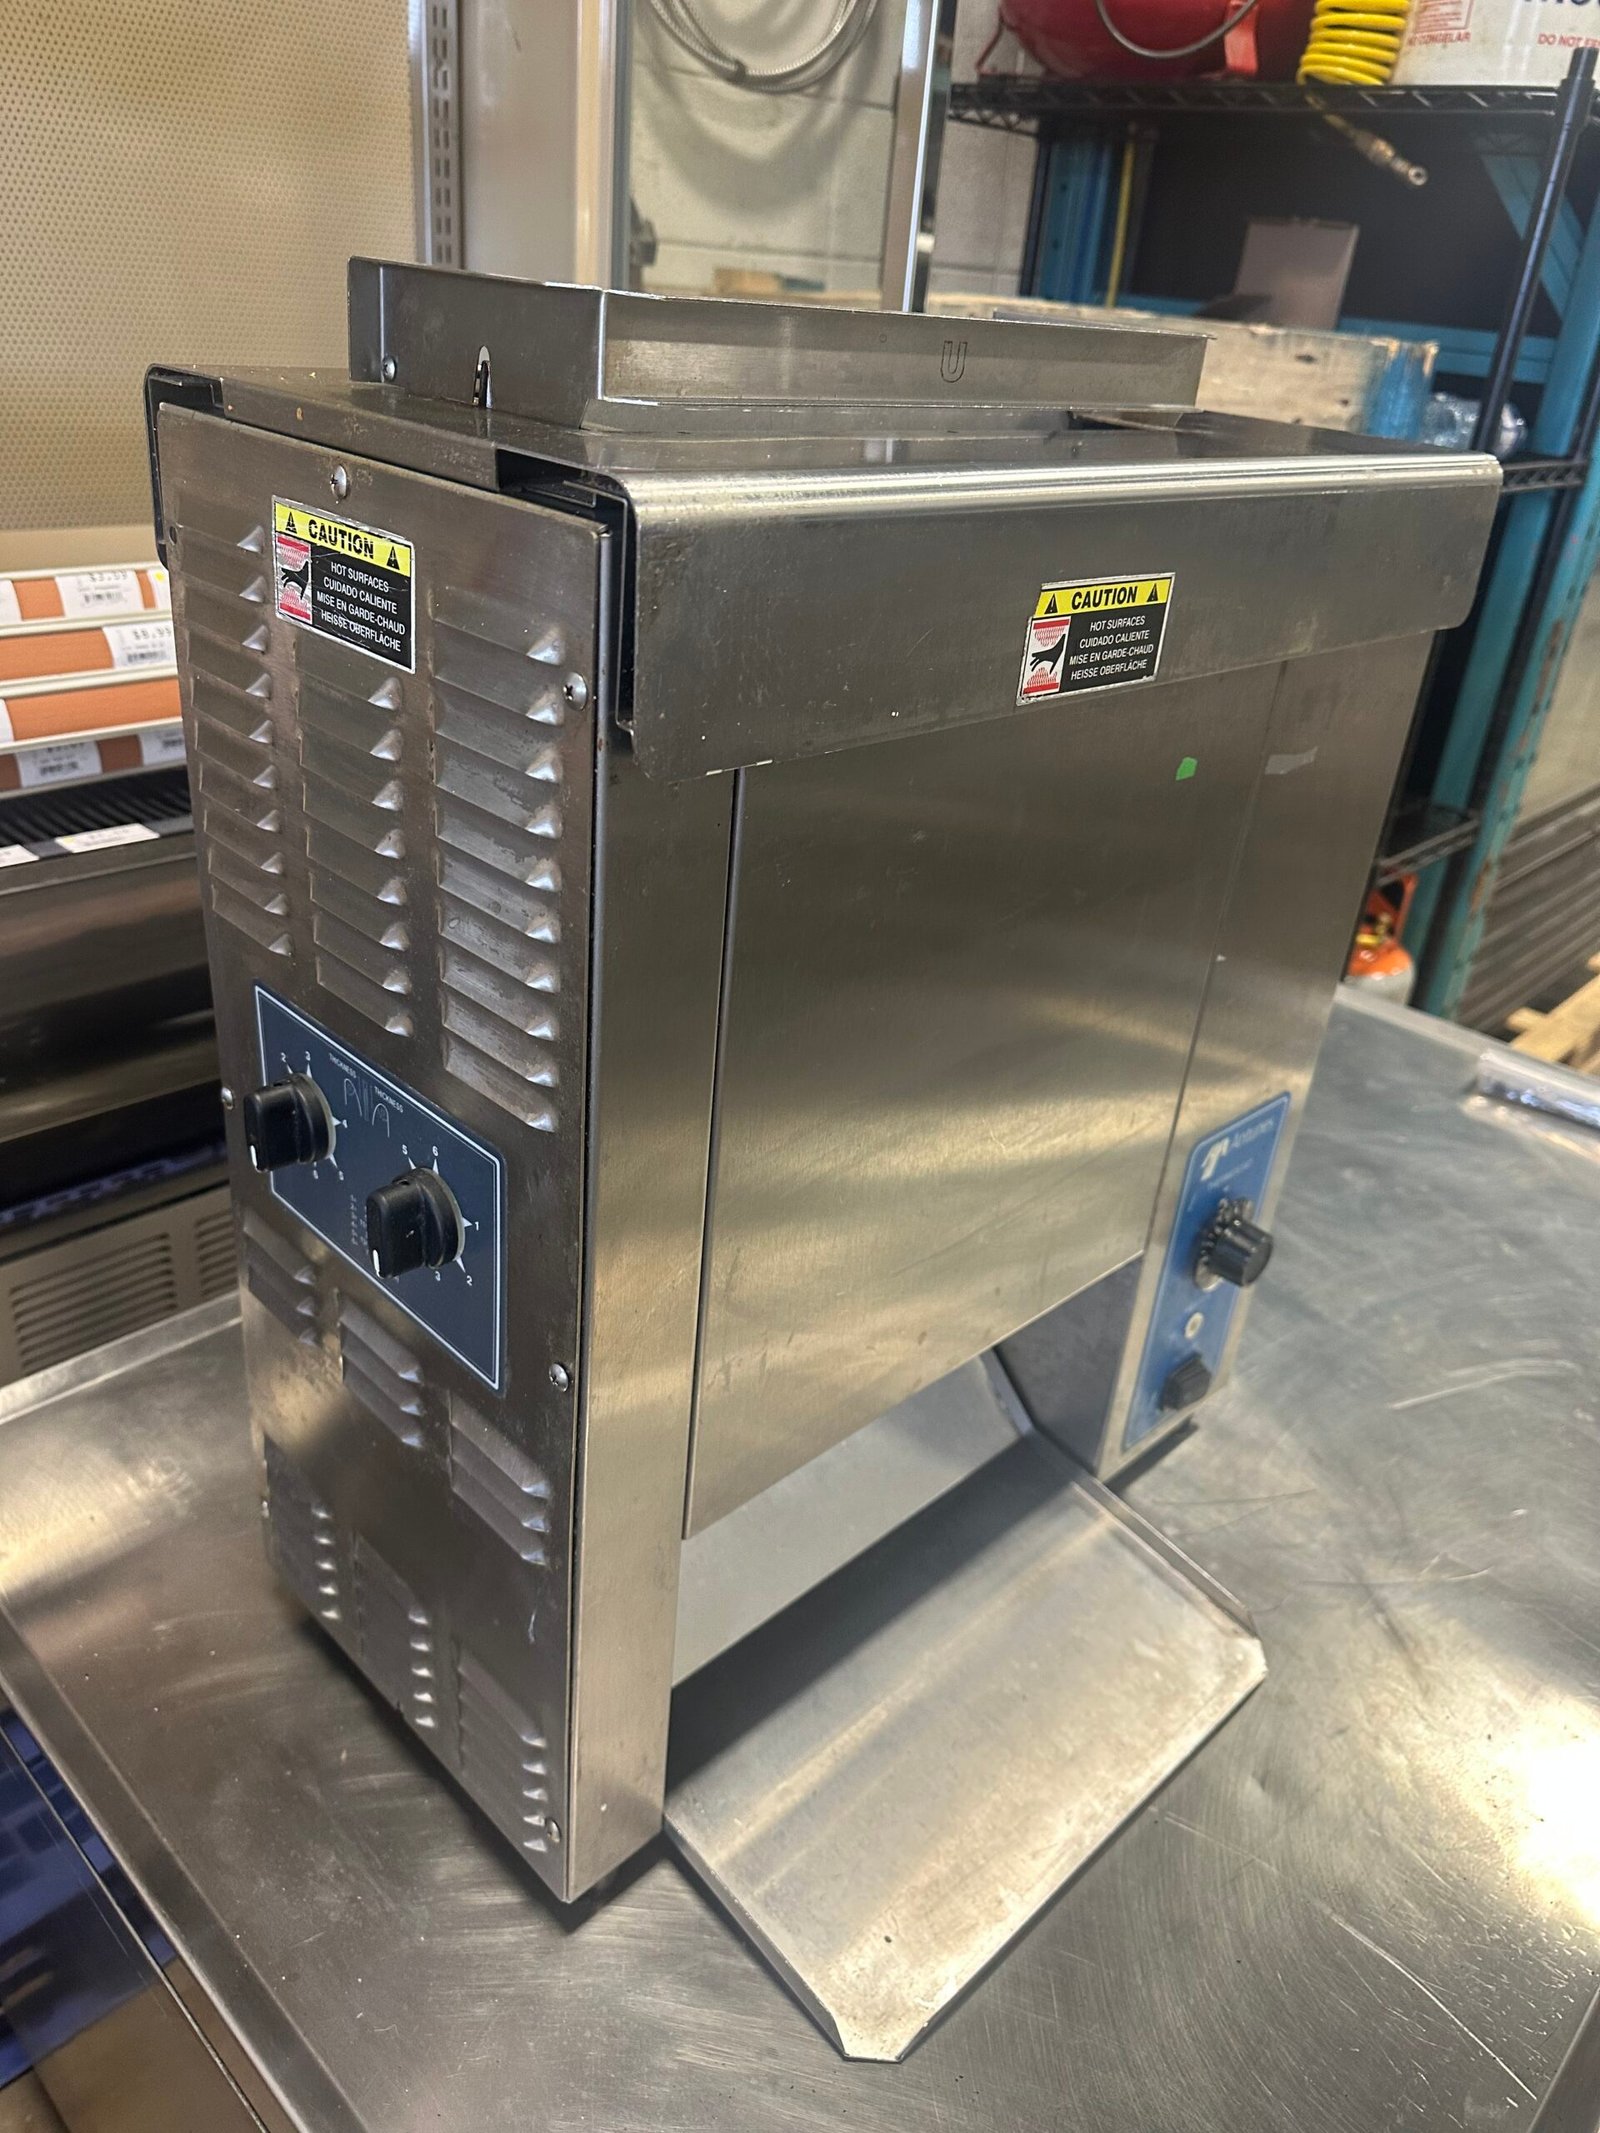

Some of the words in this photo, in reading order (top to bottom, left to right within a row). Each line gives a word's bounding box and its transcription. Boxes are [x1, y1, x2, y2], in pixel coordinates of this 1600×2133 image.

[1537, 33, 1557, 46] DO
[1559, 35, 1583, 47] NOT
[308, 519, 374, 559] CAUTION
[331, 561, 347, 577] HOT
[347, 567, 390, 593] SURFACES
[323, 576, 358, 599] CUIDADO
[359, 590, 398, 614] CALIENTE
[1071, 586, 1138, 611] CAUTION
[316, 590, 335, 608] MISE
[336, 598, 347, 612] EN
[348, 603, 406, 635] GARDE-CHAUD
[321, 609, 348, 630] HEISSE
[1089, 620, 1107, 632] HOT
[1106, 615, 1146, 630] SURFACES
[1079, 634, 1114, 649] CUIDADO
[1115, 629, 1151, 644] CALIENTE
[1069, 653, 1089, 666] MISE
[1089, 652, 1101, 663] EN
[1101, 643, 1154, 661] GARDE-CHAUD
[1070, 667, 1099, 681] HEISSE
[280, 1052, 287, 1063] 2
[328, 1052, 357, 1079] THICKNESS
[373, 1086, 404, 1114] THICKNESS
[401, 1144, 409, 1155] 5
[432, 1145, 439, 1157] 6
[474, 1221, 480, 1231] 1
[465, 1275, 473, 1287] 2
